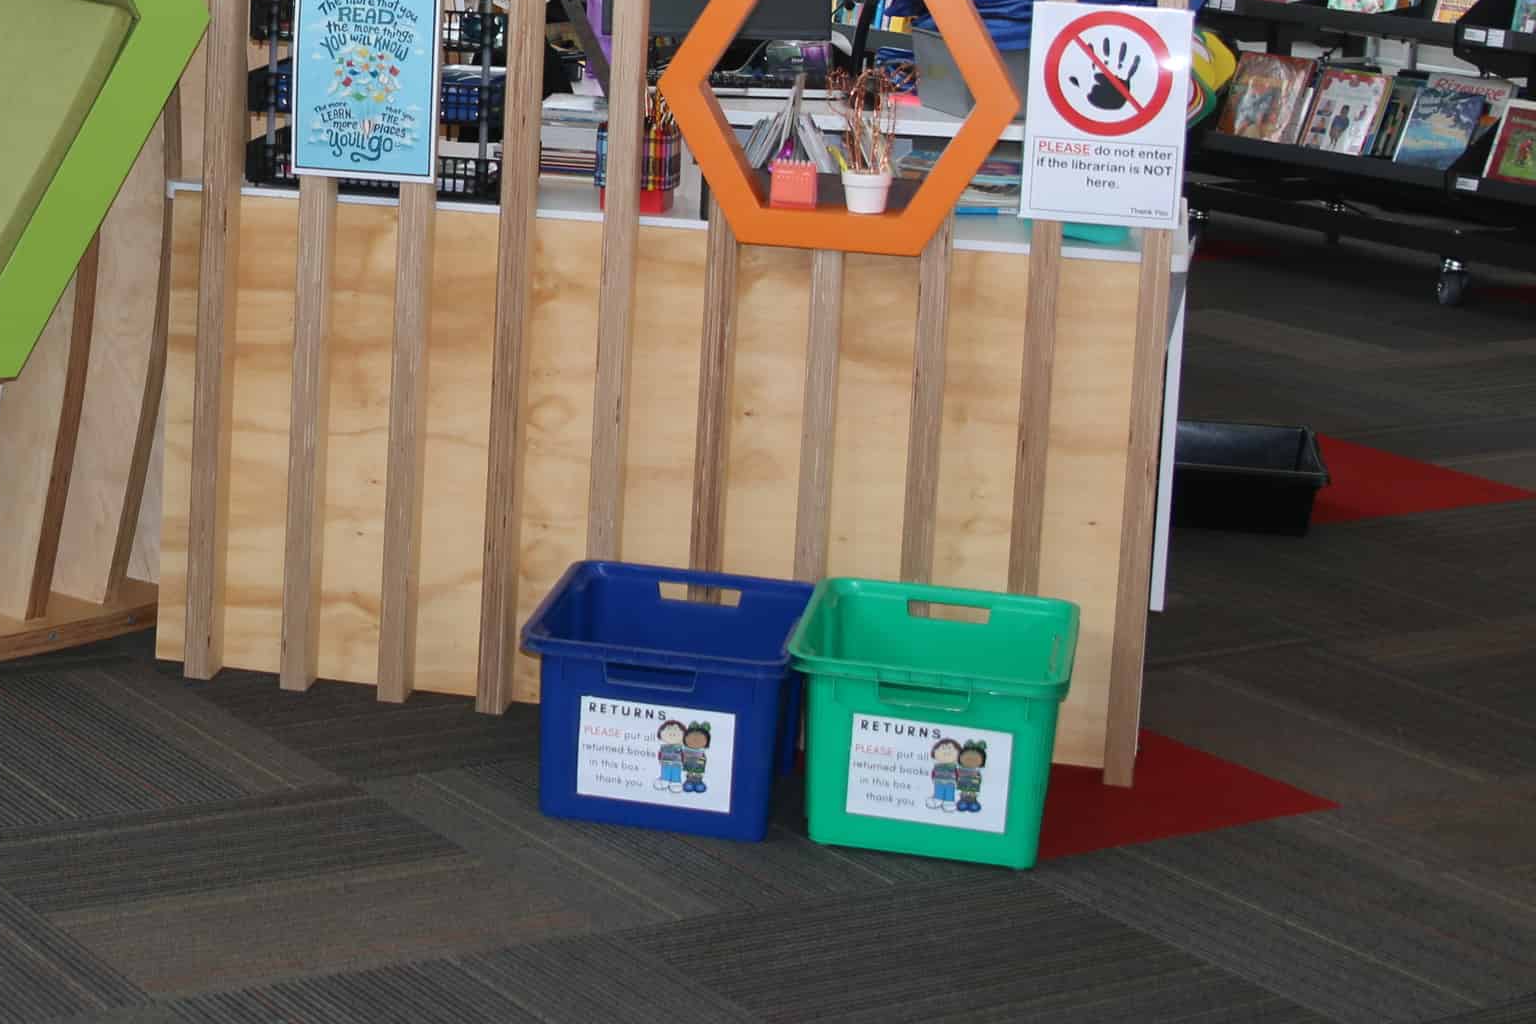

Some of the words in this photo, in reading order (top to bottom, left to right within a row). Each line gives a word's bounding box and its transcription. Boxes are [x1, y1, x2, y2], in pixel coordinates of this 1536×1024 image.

[396, 6, 418, 23] you
[326, 20, 349, 34] the
[353, 23, 380, 35] more
[382, 27, 415, 44] things
[319, 33, 347, 60] YOU
[349, 34, 373, 46] will
[373, 36, 409, 62] KNOW
[320, 107, 352, 123] LEARN
[381, 112, 399, 126] THE
[332, 120, 358, 132] more
[350, 135, 394, 163] go
[1038, 139, 1091, 156] PLEASE
[1094, 144, 1112, 157] do
[1114, 147, 1136, 160] not
[1138, 150, 1173, 162] enter
[1036, 156, 1047, 168] if
[1047, 157, 1069, 169] the
[1071, 159, 1126, 173] librarian
[1128, 163, 1140, 175] is
[1143, 164, 1173, 177] NOT
[1085, 176, 1120, 190] here.
[589, 702, 667, 721] RETURNS
[583, 725, 624, 738] PLEASE
[624, 732, 641, 743] put
[643, 733, 657, 743] all
[861, 719, 941, 739] RETURNS
[582, 743, 625, 755] returned
[626, 746, 657, 758] books
[854, 743, 895, 757] PLEASE
[896, 751, 916, 761] put
[916, 751, 930, 761] all
[589, 759, 599, 767] in
[601, 759, 618, 770] this
[621, 761, 640, 771] box
[852, 760, 897, 773] returned
[898, 763, 930, 776] books
[595, 773, 622, 786] thank
[624, 779, 644, 789] you
[859, 777, 870, 785] in
[871, 776, 890, 788] this
[865, 791, 894, 803] thank
[895, 797, 915, 807] you
